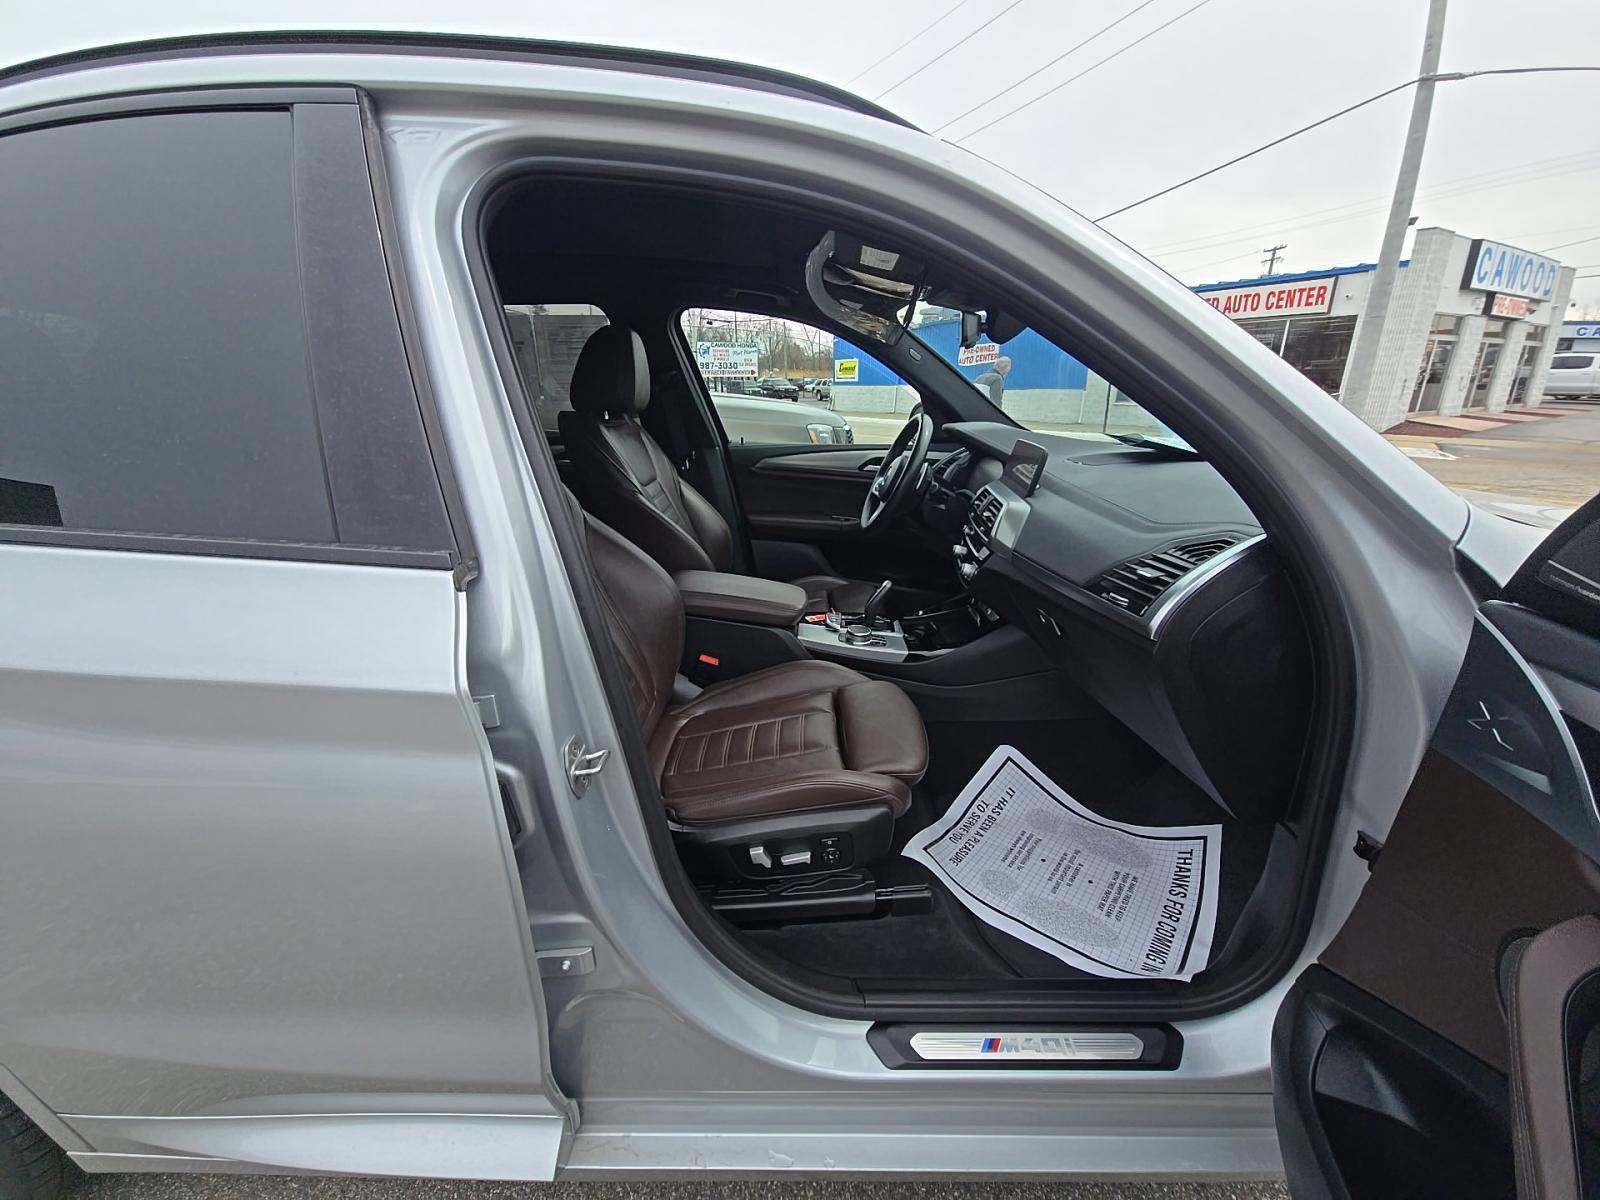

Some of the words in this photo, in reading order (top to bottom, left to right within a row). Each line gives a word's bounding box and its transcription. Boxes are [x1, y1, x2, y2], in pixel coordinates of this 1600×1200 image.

[1477, 247, 1555, 296] CAWOOD
[1223, 293, 1260, 314] AUTO
[1265, 286, 1327, 311] CENTER
[700, 361, 739, 370] 987-3030
[959, 355, 974, 365] AUTO
[1005, 787, 1016, 799] IT
[976, 799, 990, 813] TO
[991, 796, 1008, 816] HAS
[959, 811, 980, 834] SERVE
[978, 814, 997, 833] BEEN
[948, 831, 963, 844] YOU
[973, 830, 984, 838] A
[949, 836, 980, 866] PLEASURE
[1168, 849, 1193, 899] THANKS
[1160, 898, 1184, 923] FOR
[1145, 920, 1177, 965] COMING
[1141, 961, 1164, 973] IN
